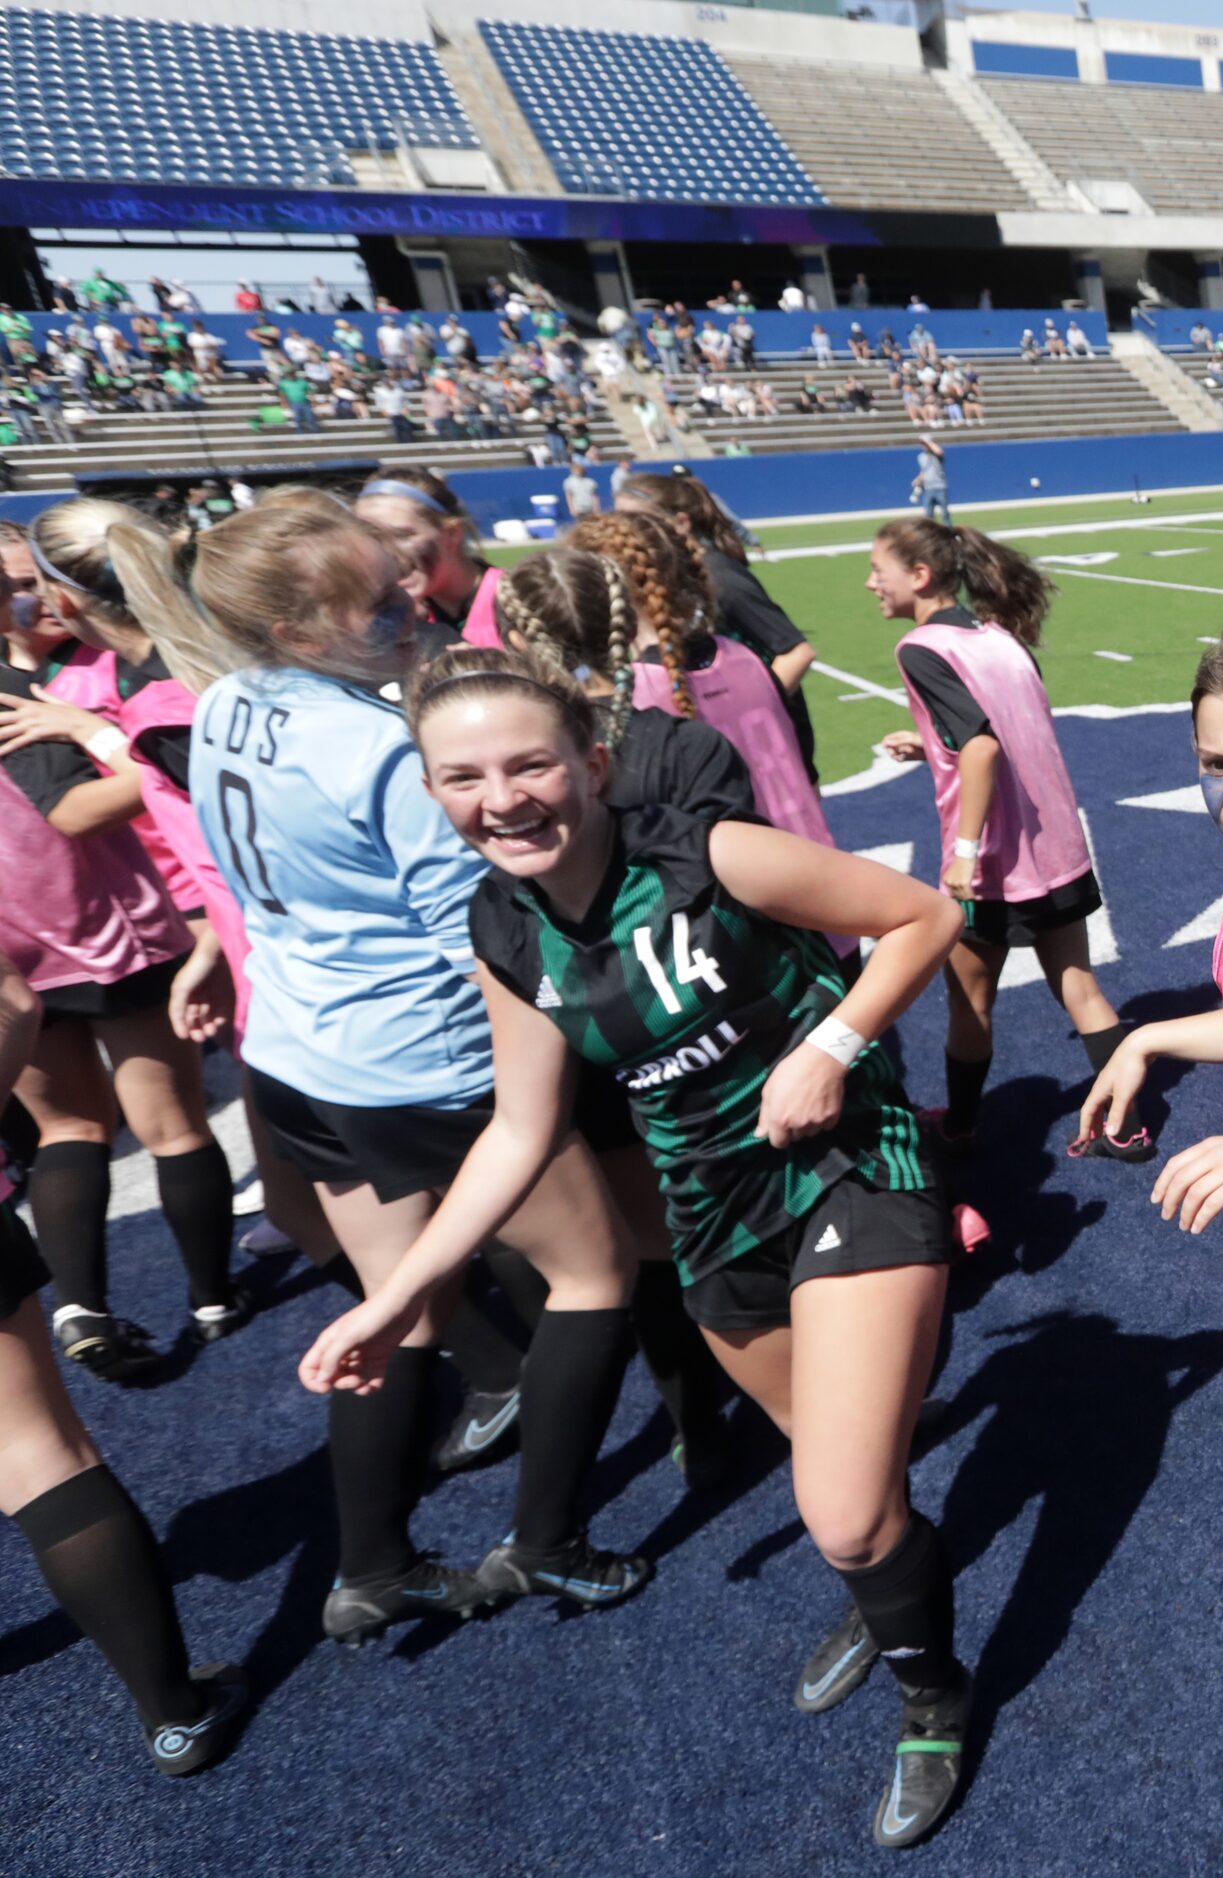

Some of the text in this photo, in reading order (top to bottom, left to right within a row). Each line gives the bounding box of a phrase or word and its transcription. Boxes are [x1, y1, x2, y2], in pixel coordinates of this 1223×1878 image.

[409, 203, 545, 231] DISTRICT
[219, 769, 288, 915] 0
[634, 912, 728, 1015] 14
